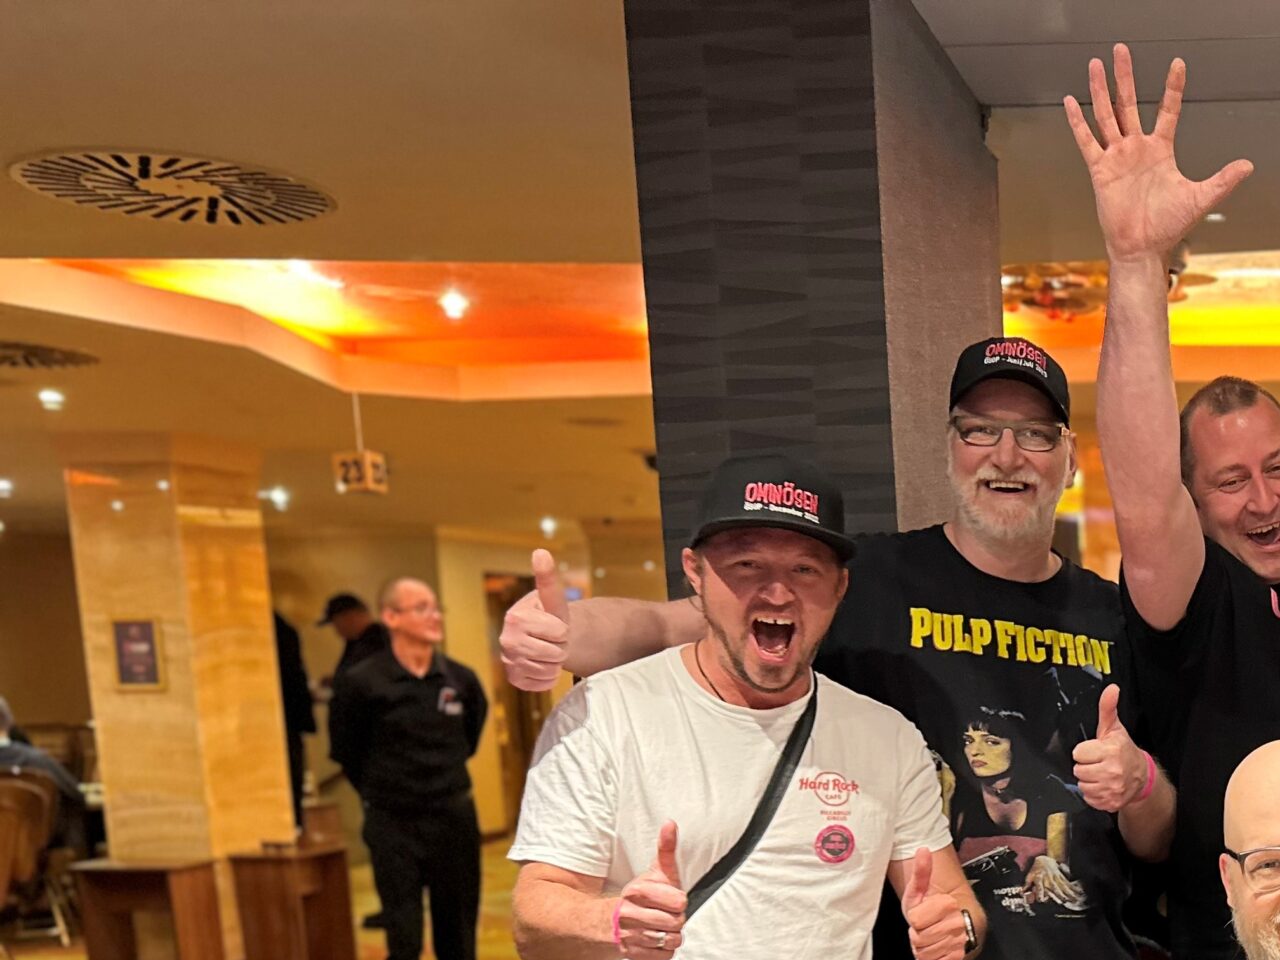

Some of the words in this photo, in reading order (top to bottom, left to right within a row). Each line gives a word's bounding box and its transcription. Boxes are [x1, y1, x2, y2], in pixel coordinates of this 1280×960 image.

[744, 481, 818, 514] OMINÖSEN
[910, 607, 992, 655] PULP
[994, 620, 1112, 675] FICTION
[799, 778, 830, 791] Hard
[831, 778, 859, 794] Rock
